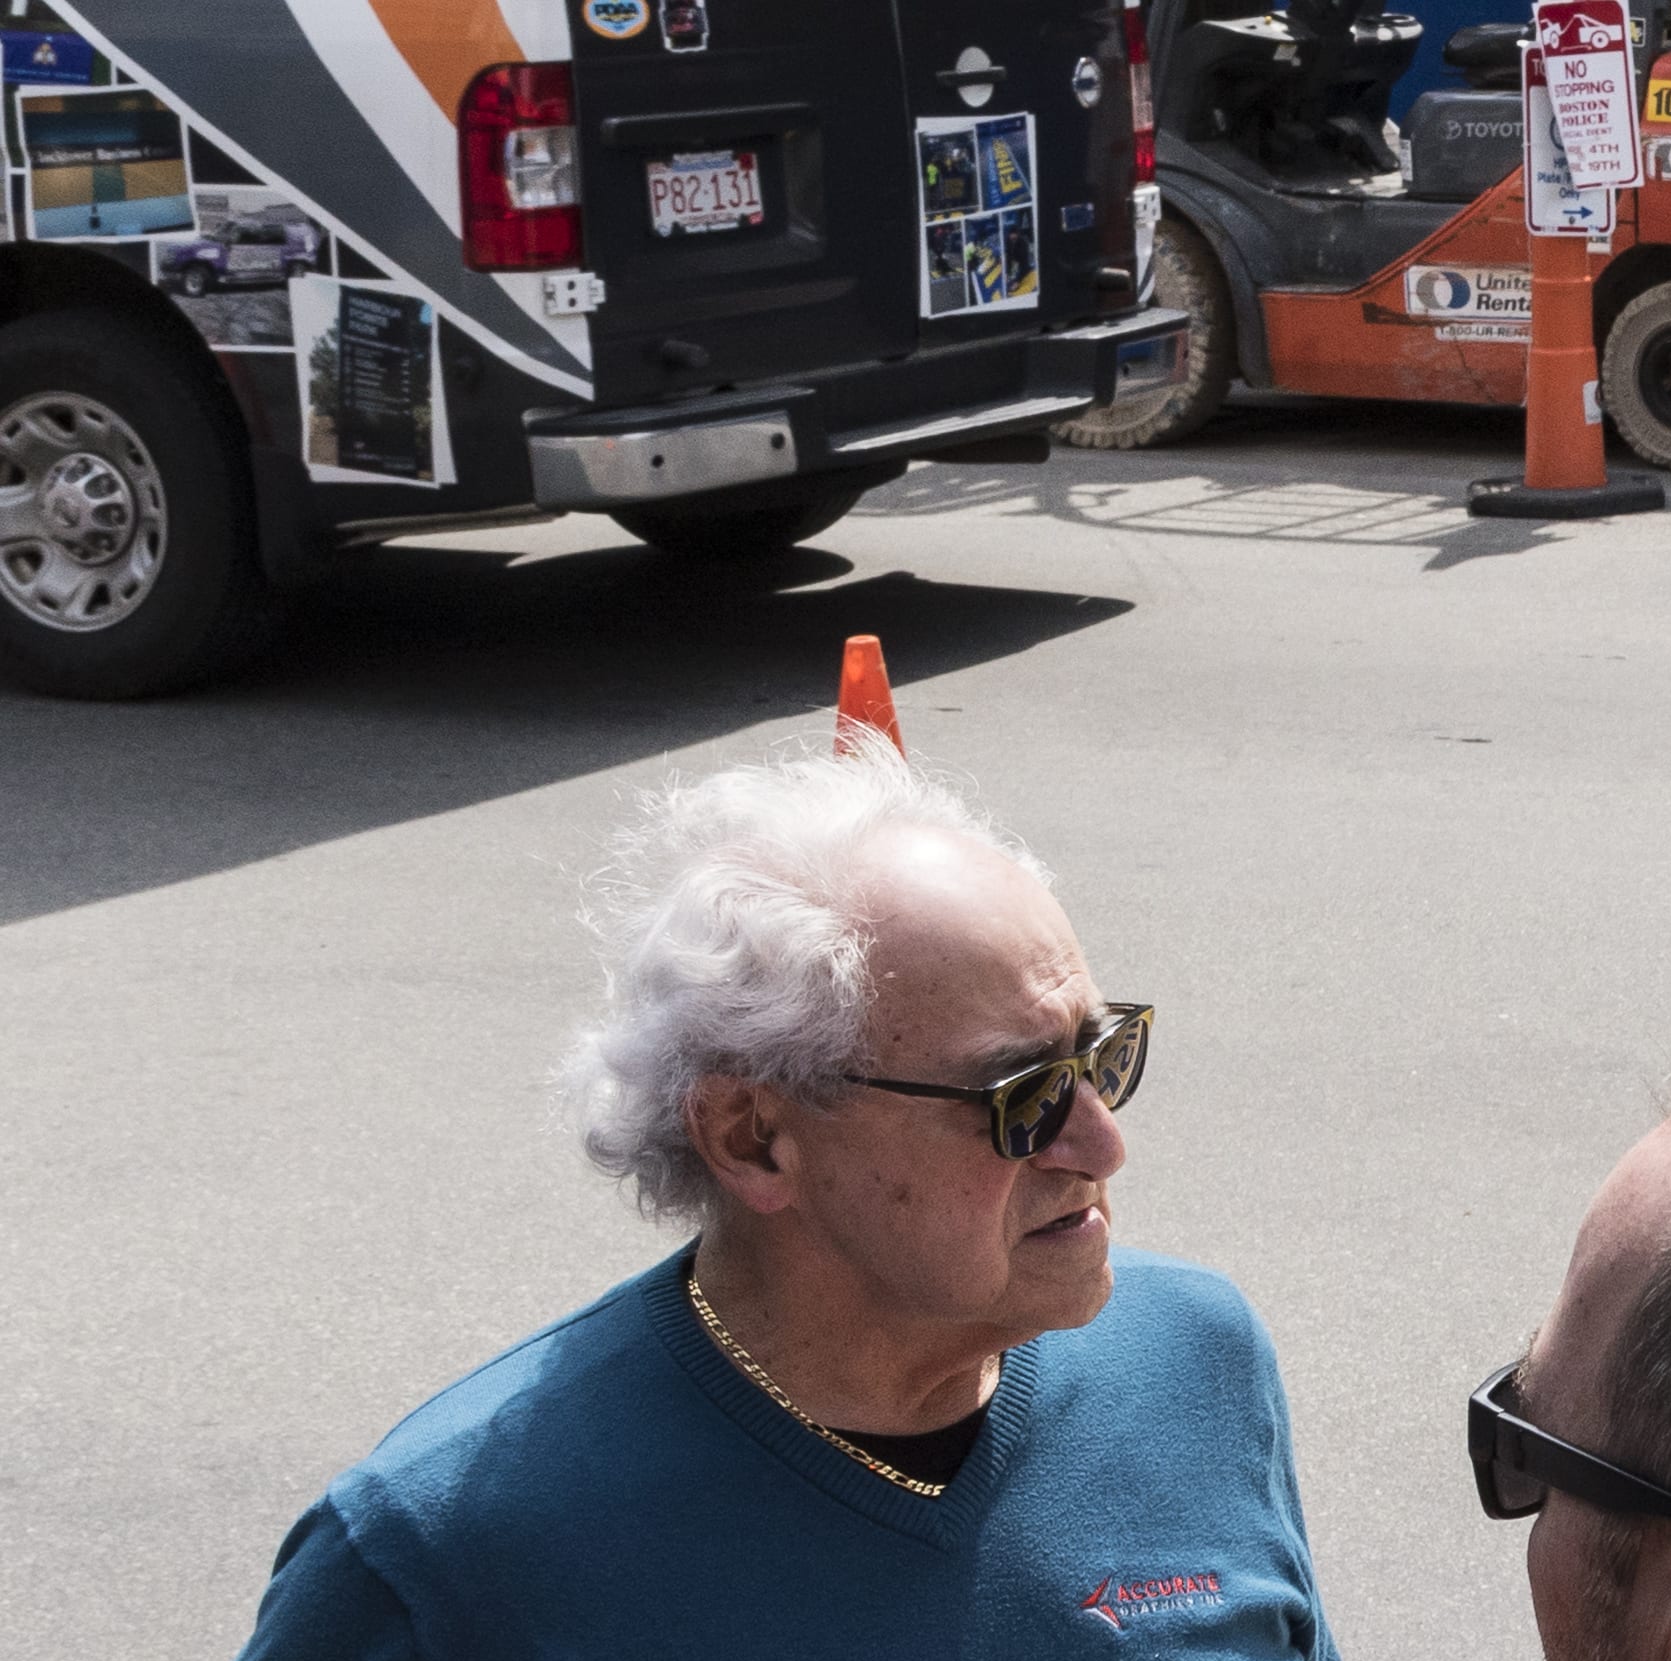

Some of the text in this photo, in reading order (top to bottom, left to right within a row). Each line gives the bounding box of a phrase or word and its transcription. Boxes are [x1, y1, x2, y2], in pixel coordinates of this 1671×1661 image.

[1564, 60, 1587, 79] NO
[1554, 79, 1615, 97] STOPPING
[1559, 98, 1610, 114] BOSTON
[1561, 111, 1609, 127] POLICE
[1464, 122, 1524, 138] TOYOT
[1476, 273, 1531, 291] Unite
[1476, 294, 1531, 311] Rent
[1117, 1573, 1220, 1602] ACCURATE
[1119, 1596, 1195, 1617] GRAPHICS
